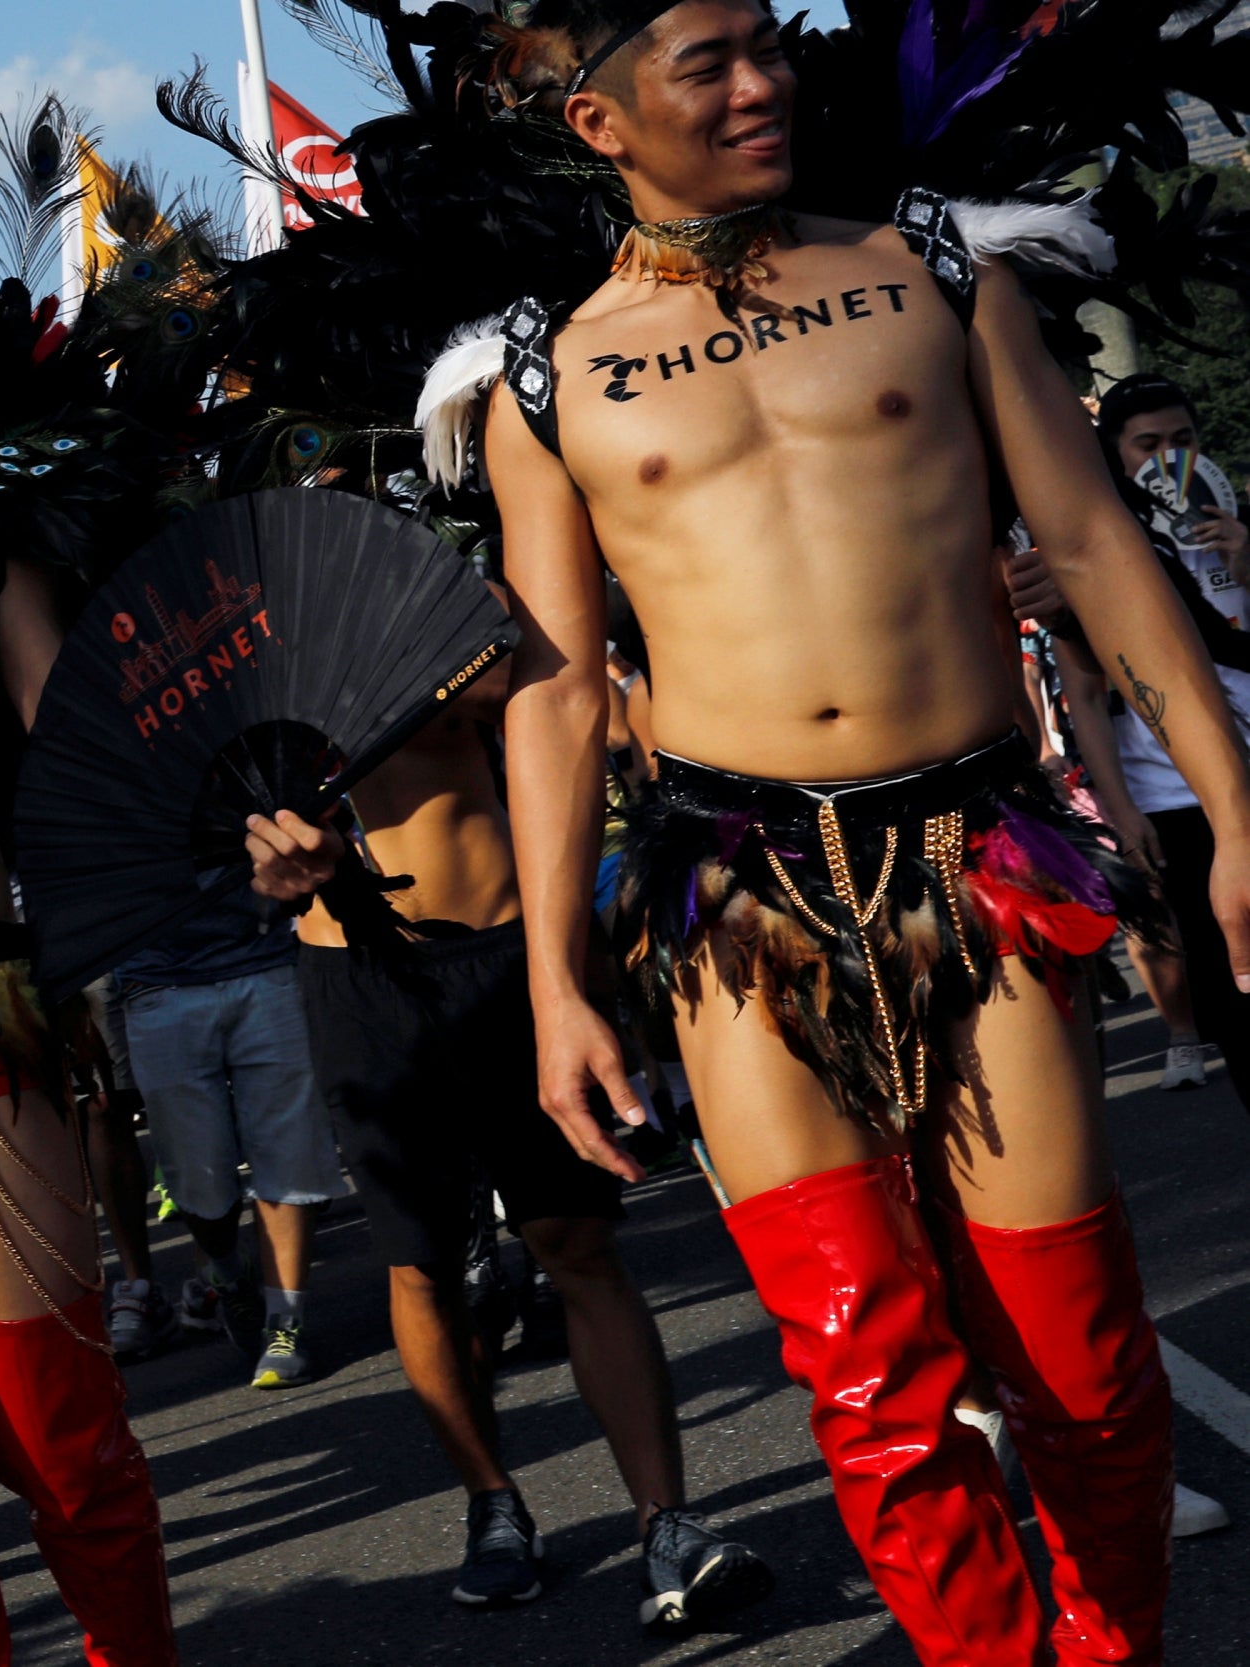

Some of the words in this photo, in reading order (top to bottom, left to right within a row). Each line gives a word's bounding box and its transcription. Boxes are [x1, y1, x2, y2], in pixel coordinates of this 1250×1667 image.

[657, 284, 908, 380] HORNET
[134, 609, 272, 739] HORNET
[447, 643, 497, 691] HORNET
